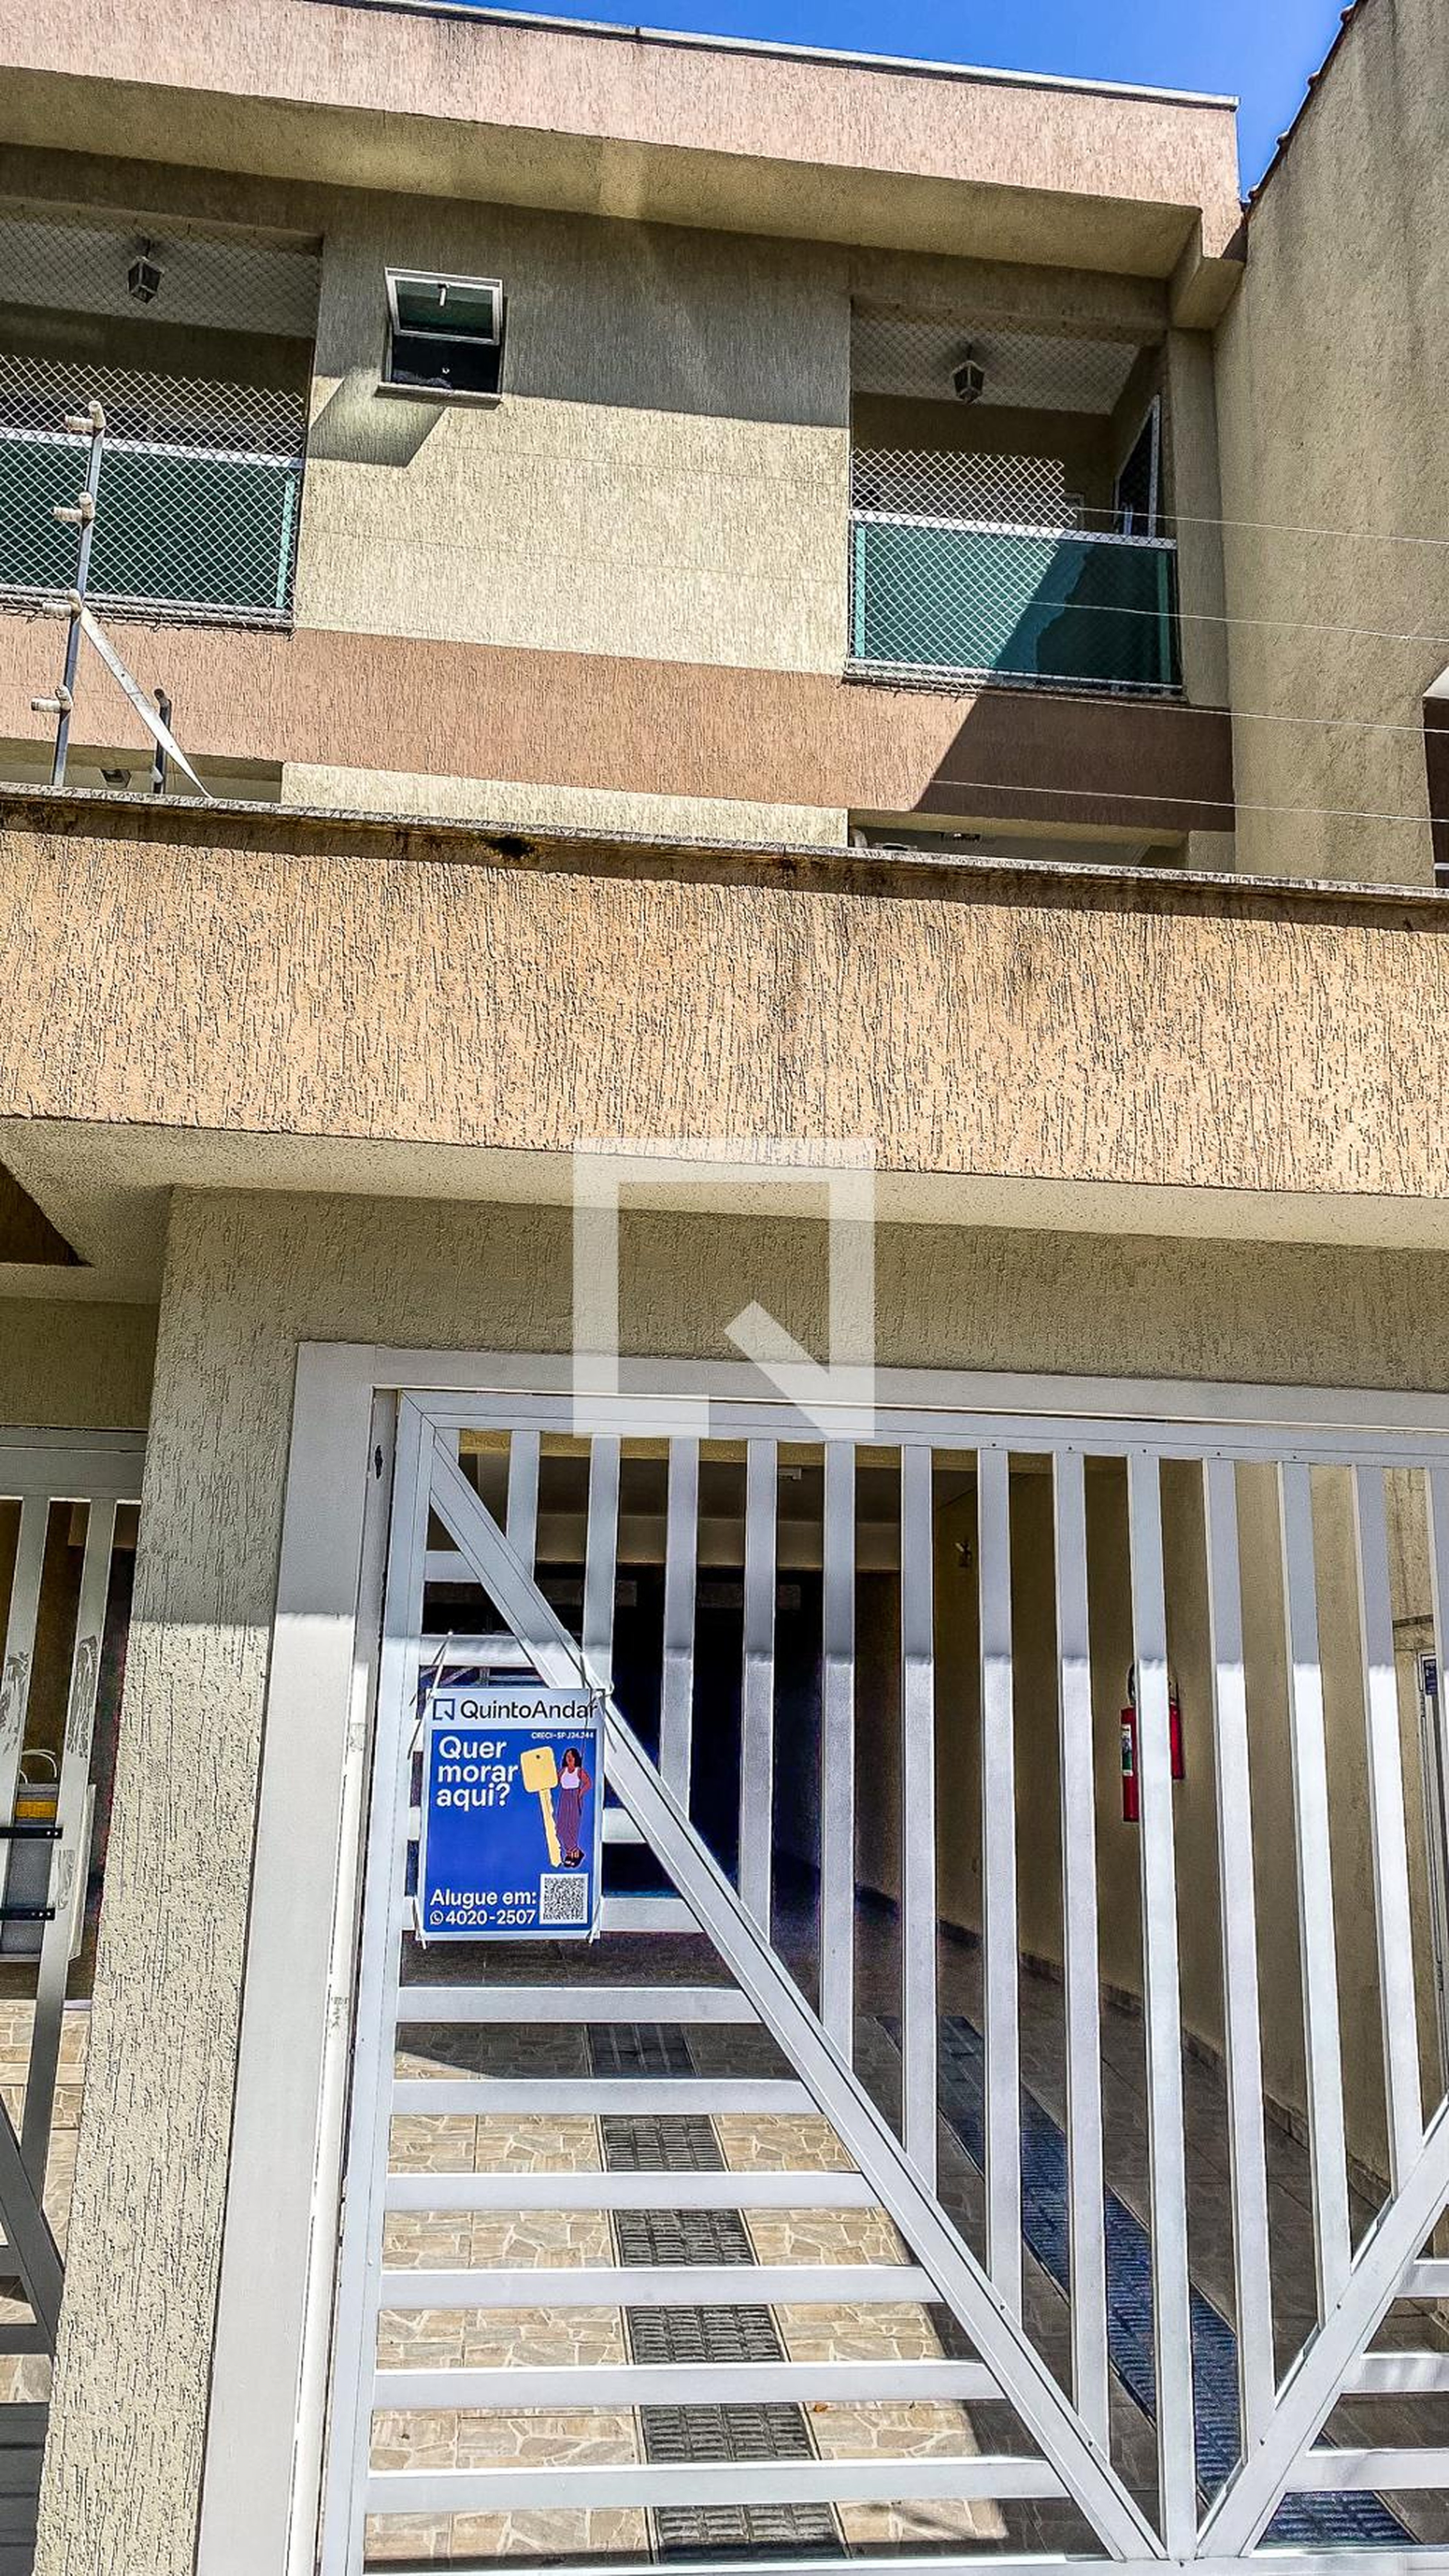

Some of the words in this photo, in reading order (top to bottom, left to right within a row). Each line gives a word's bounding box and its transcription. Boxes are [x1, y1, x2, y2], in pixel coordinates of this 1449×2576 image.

[460, 1699, 598, 1720] QuintoAndar
[438, 1736, 507, 1760] Quer
[438, 1765, 518, 1783] morar
[437, 1783, 511, 1811] aqui?
[430, 1889, 498, 1911] Alugue
[502, 1891, 537, 1905] em:
[445, 1909, 536, 1925] 4020-2507
